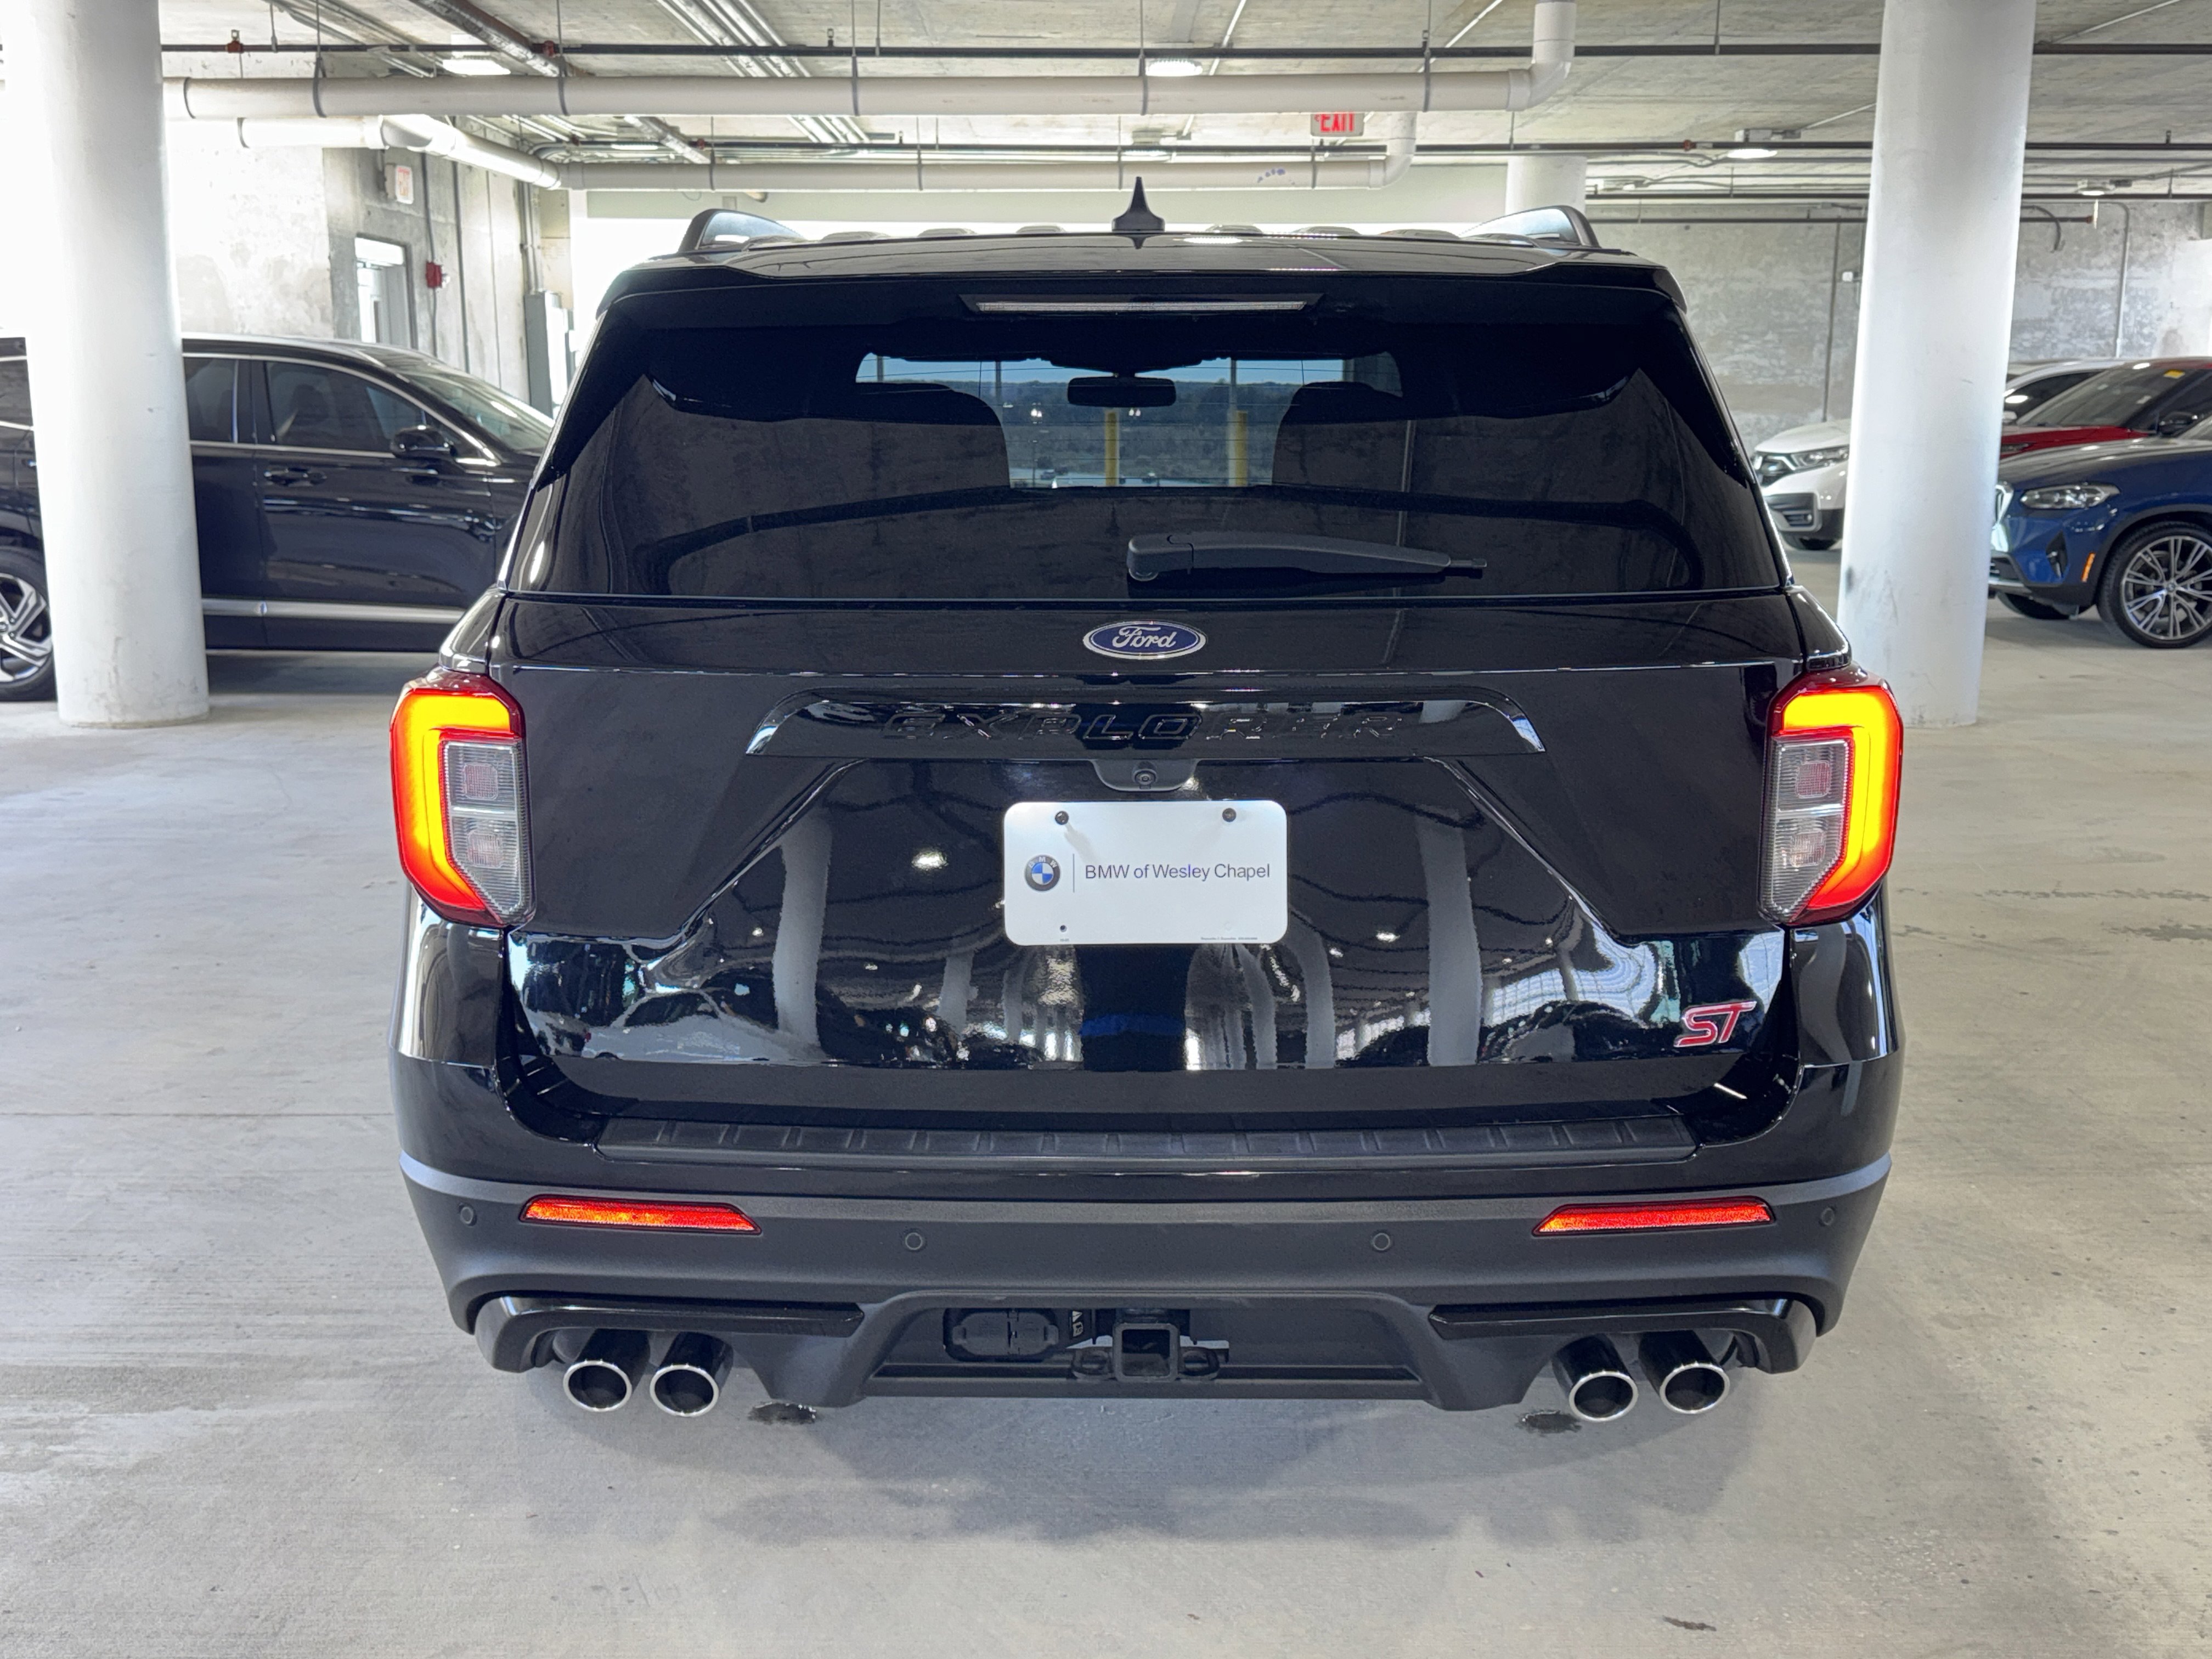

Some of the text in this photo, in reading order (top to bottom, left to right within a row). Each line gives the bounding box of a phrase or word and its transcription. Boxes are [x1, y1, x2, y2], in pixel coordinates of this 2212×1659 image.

[1320, 112, 1354, 132] EXIT
[1112, 626, 1177, 648] Ford
[882, 713, 1402, 741] EXPLORER
[1086, 864, 1270, 882] BMW of Wesley Chapel
[1674, 1001, 1757, 1047] ST
